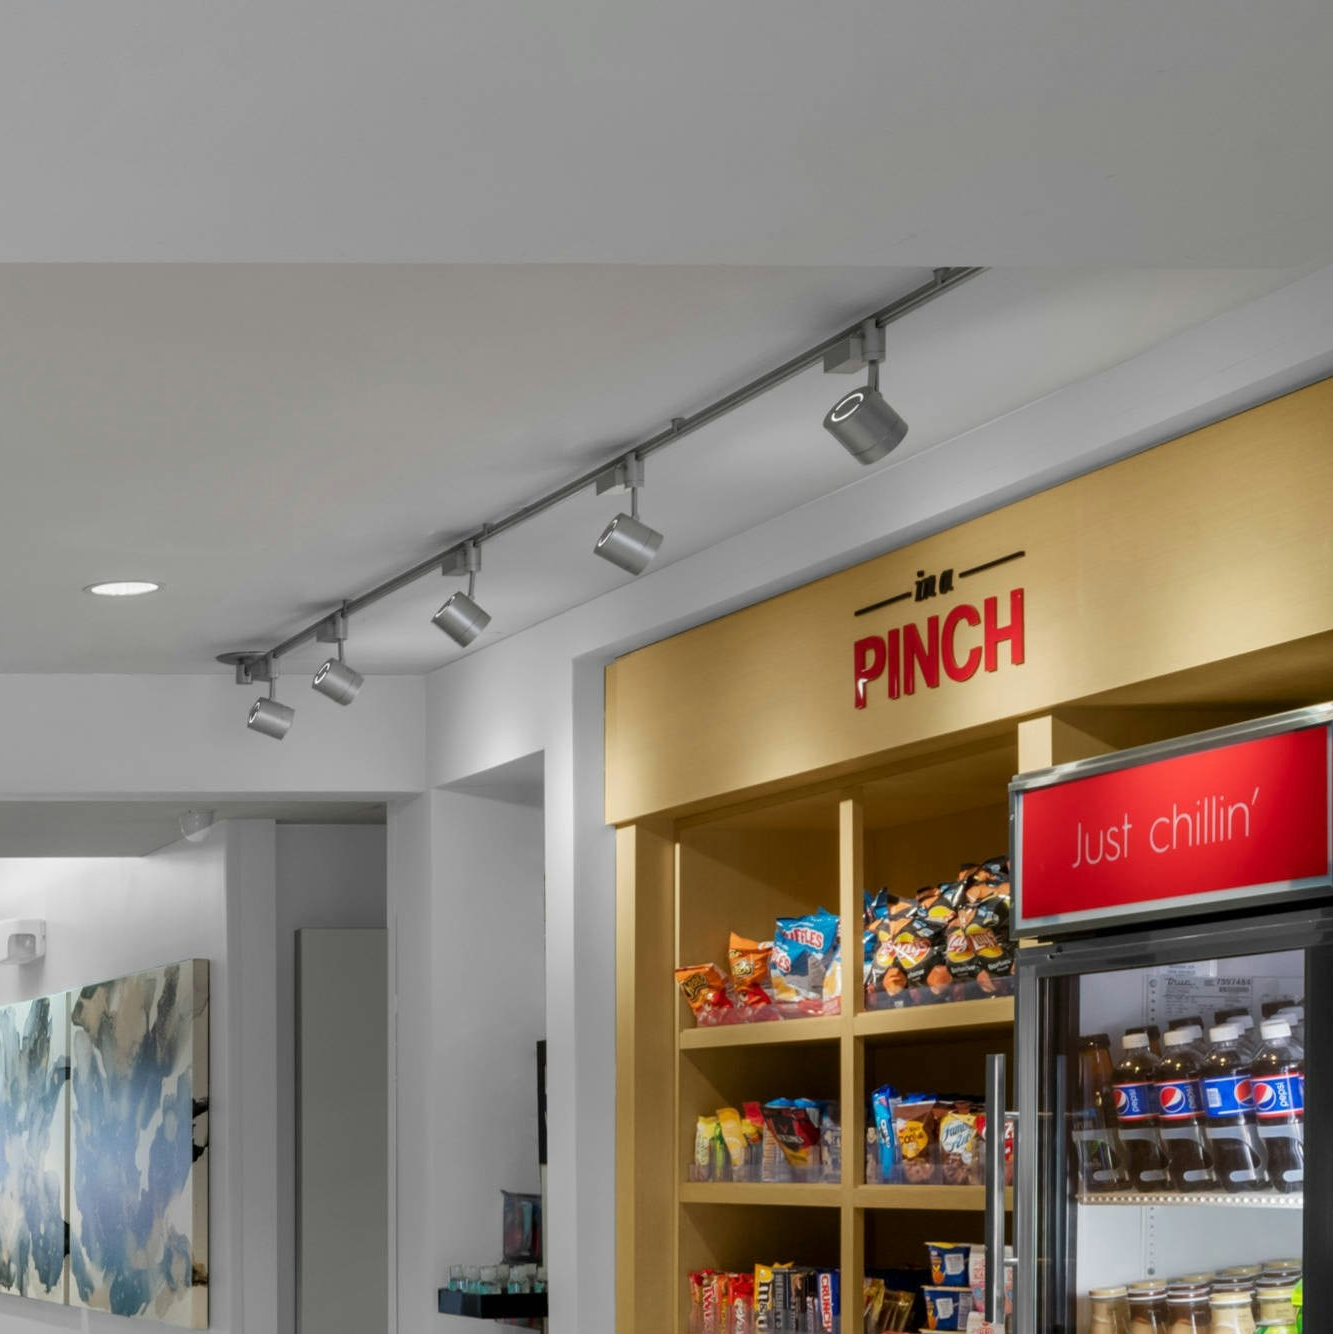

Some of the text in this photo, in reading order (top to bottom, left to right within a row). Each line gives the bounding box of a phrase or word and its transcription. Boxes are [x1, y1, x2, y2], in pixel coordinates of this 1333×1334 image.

[914, 568, 954, 602] in a
[854, 588, 1025, 710] PINCH
[1071, 812, 1132, 868] Just
[1129, 1088, 1140, 1113] pepsi
[1275, 1081, 1289, 1108] pepsi
[820, 1274, 832, 1333] CRUNCH
